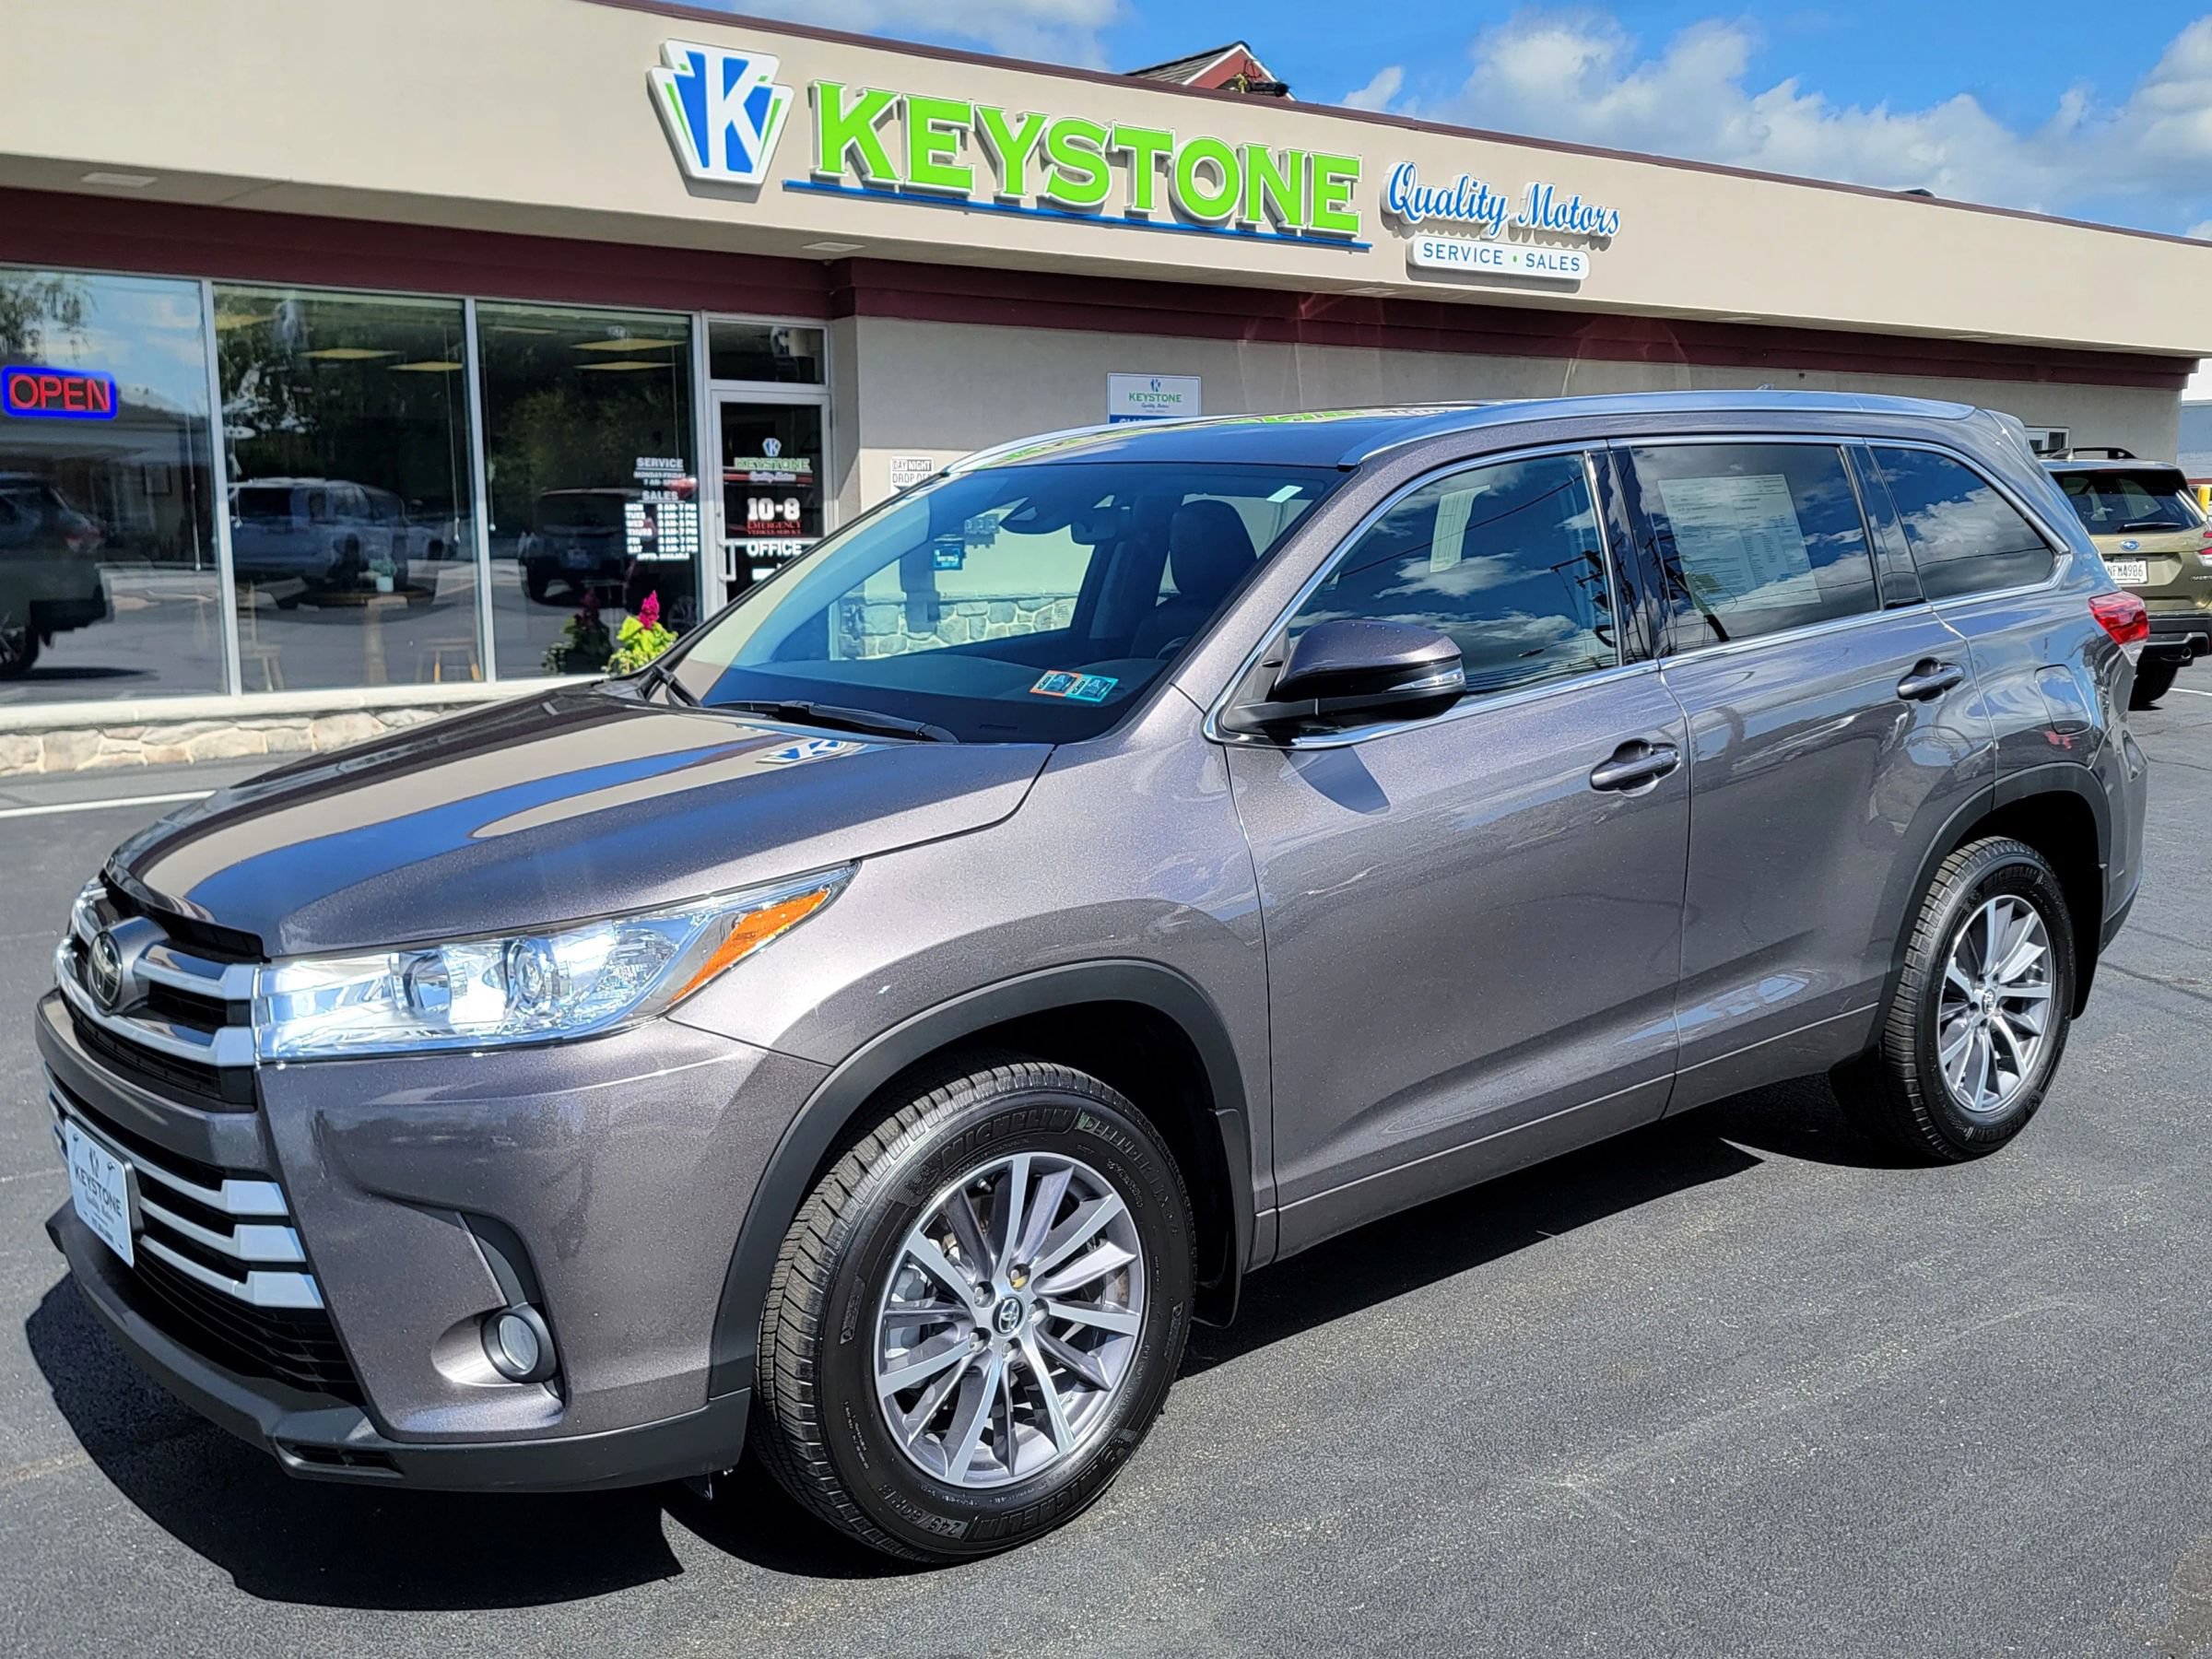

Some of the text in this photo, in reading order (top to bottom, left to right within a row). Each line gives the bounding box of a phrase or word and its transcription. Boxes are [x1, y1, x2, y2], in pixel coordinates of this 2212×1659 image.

[811, 80, 1362, 236] KEYSTONE
[1387, 160, 1621, 239] Quality Motors
[1422, 241, 1582, 274] SERVICE SALES
[8, 373, 111, 412] OPEN
[1128, 393, 1182, 404] KEYSTONE
[636, 457, 684, 468] SERVICE
[735, 458, 810, 471] KEYSTONE
[893, 460, 930, 471] DAY NIGHT
[892, 473, 930, 483] DROP OF
[641, 490, 679, 501] SALES
[747, 497, 801, 522] 10-8
[747, 541, 803, 558] OFFICE
[941, 1108, 1075, 1168] MICHELIN
[74, 1163, 123, 1218] KEYSTONE
